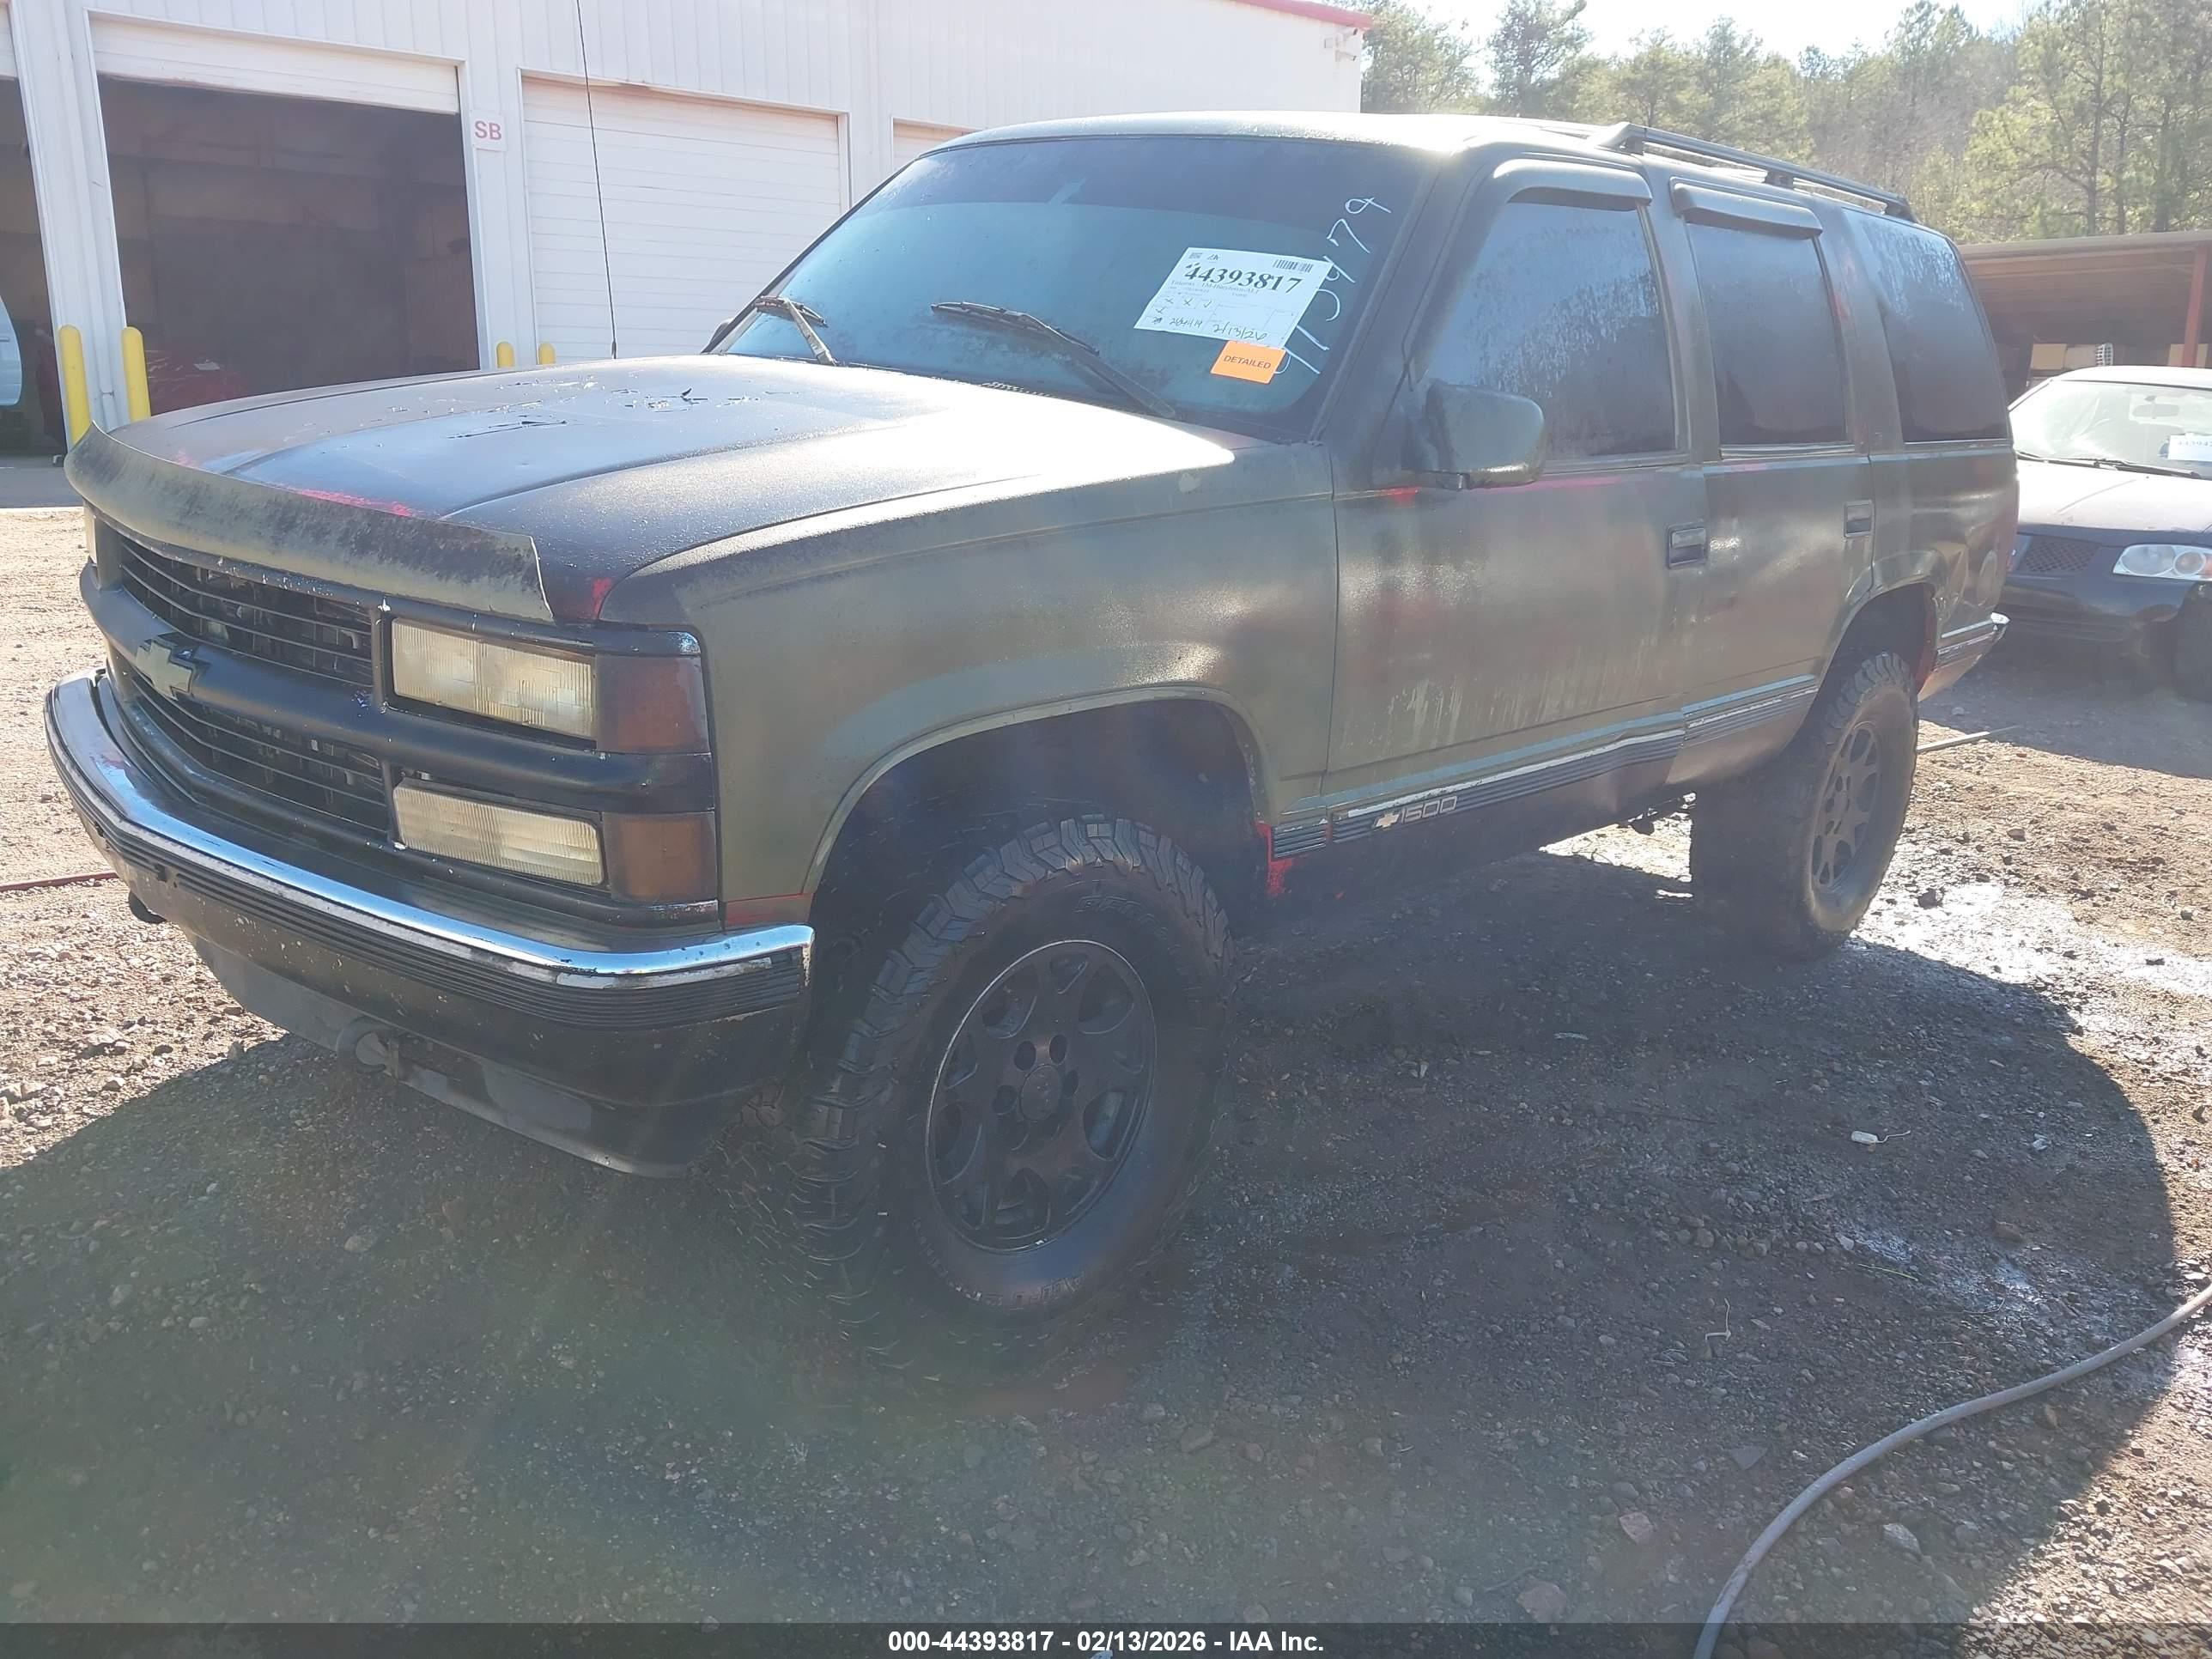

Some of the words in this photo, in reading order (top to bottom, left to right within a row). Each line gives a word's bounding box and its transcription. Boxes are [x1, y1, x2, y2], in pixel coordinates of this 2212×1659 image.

[474, 120, 502, 140] SB
[1183, 263, 1304, 294] 44393817
[1223, 355, 1272, 369] DETAILED
[1401, 795, 1457, 823] 1500
